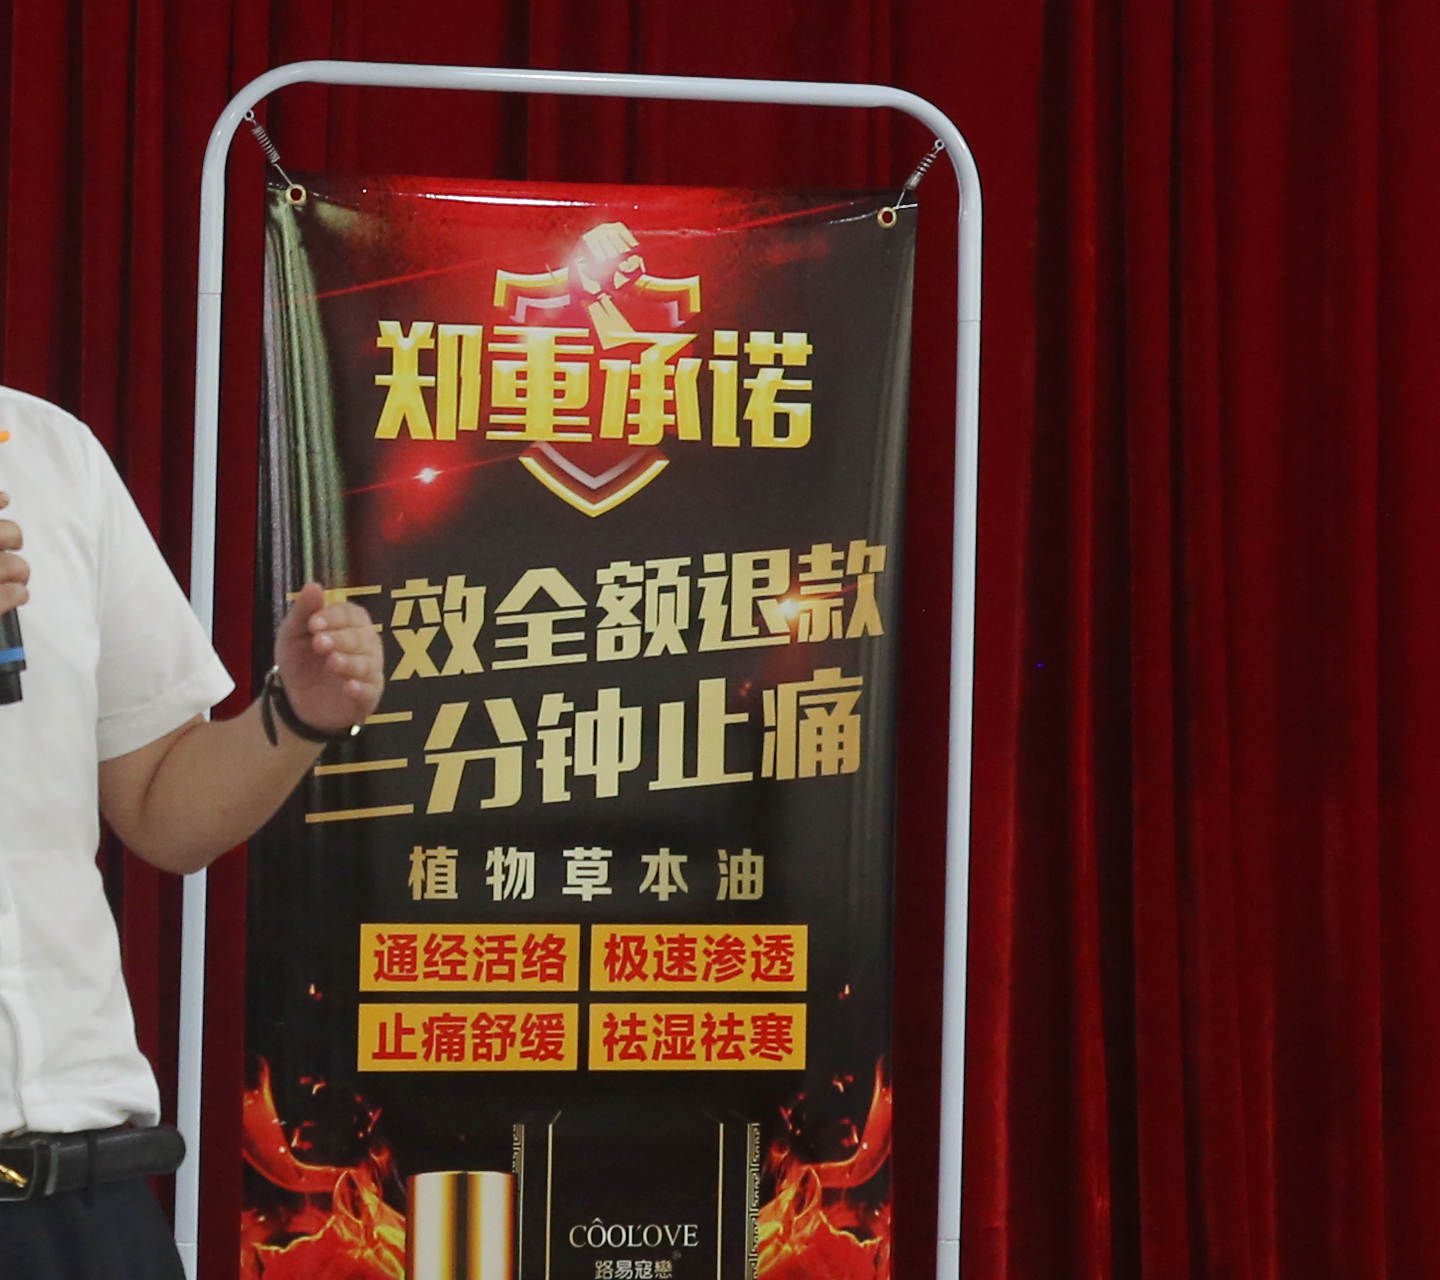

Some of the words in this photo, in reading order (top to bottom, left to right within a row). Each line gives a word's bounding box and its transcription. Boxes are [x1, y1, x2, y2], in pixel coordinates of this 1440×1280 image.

[373, 320, 814, 449] 郑重承诺
[286, 539, 888, 681] 效全额退款
[304, 668, 864, 824] 三分钟止痛
[408, 845, 765, 903] 植物草本油
[373, 932, 568, 984] 通经活络
[603, 932, 796, 984] 极速渗透
[371, 1011, 566, 1063] 止痛舒缓
[602, 1011, 795, 1063] 祛湿祛寒
